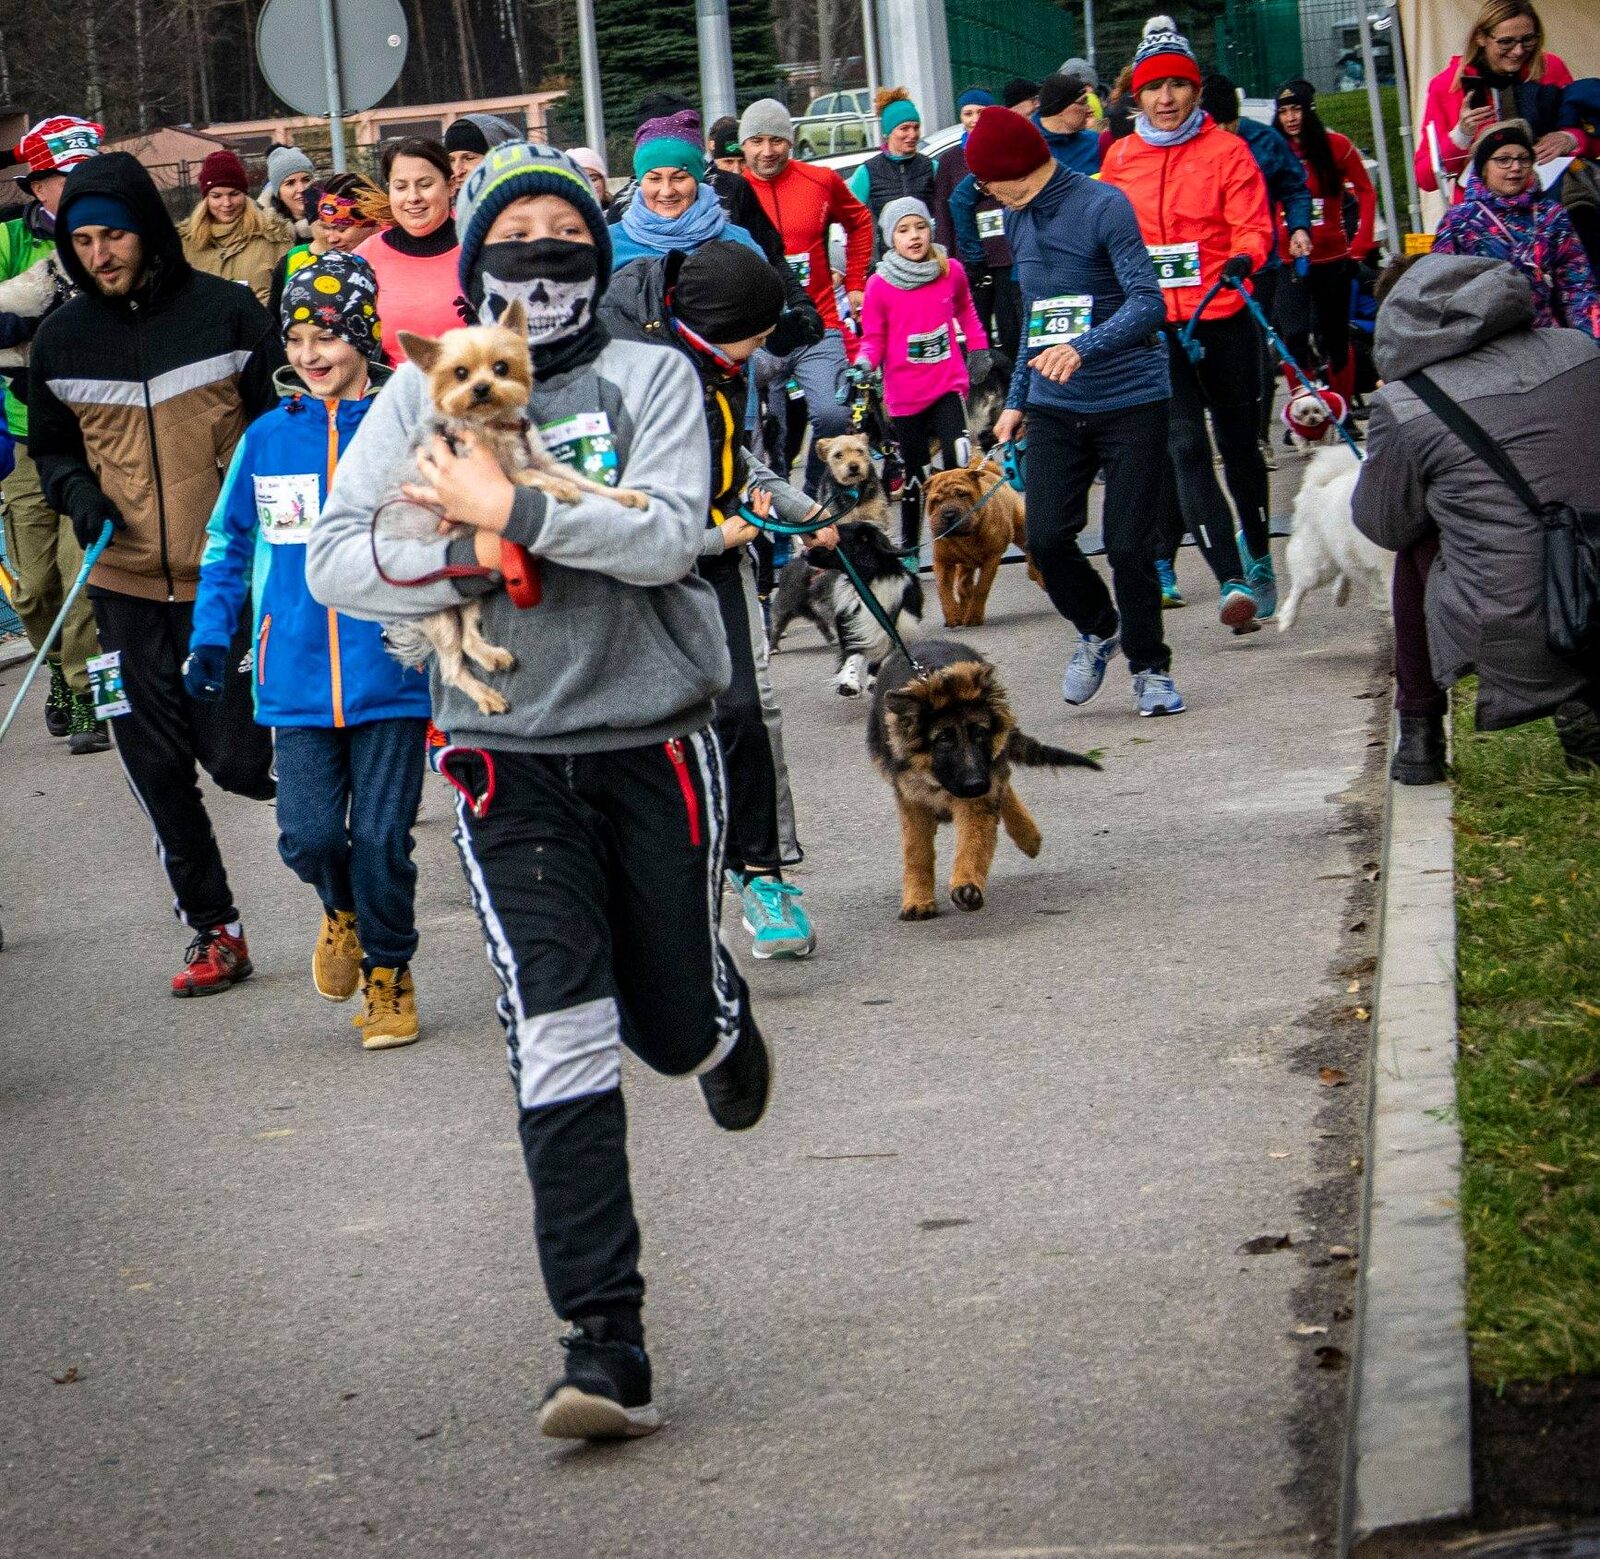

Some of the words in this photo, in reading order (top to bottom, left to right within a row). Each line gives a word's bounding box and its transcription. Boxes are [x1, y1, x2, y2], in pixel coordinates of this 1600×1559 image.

[67, 138, 88, 148] 26
[1161, 264, 1174, 277] 6
[1045, 316, 1070, 333] 49
